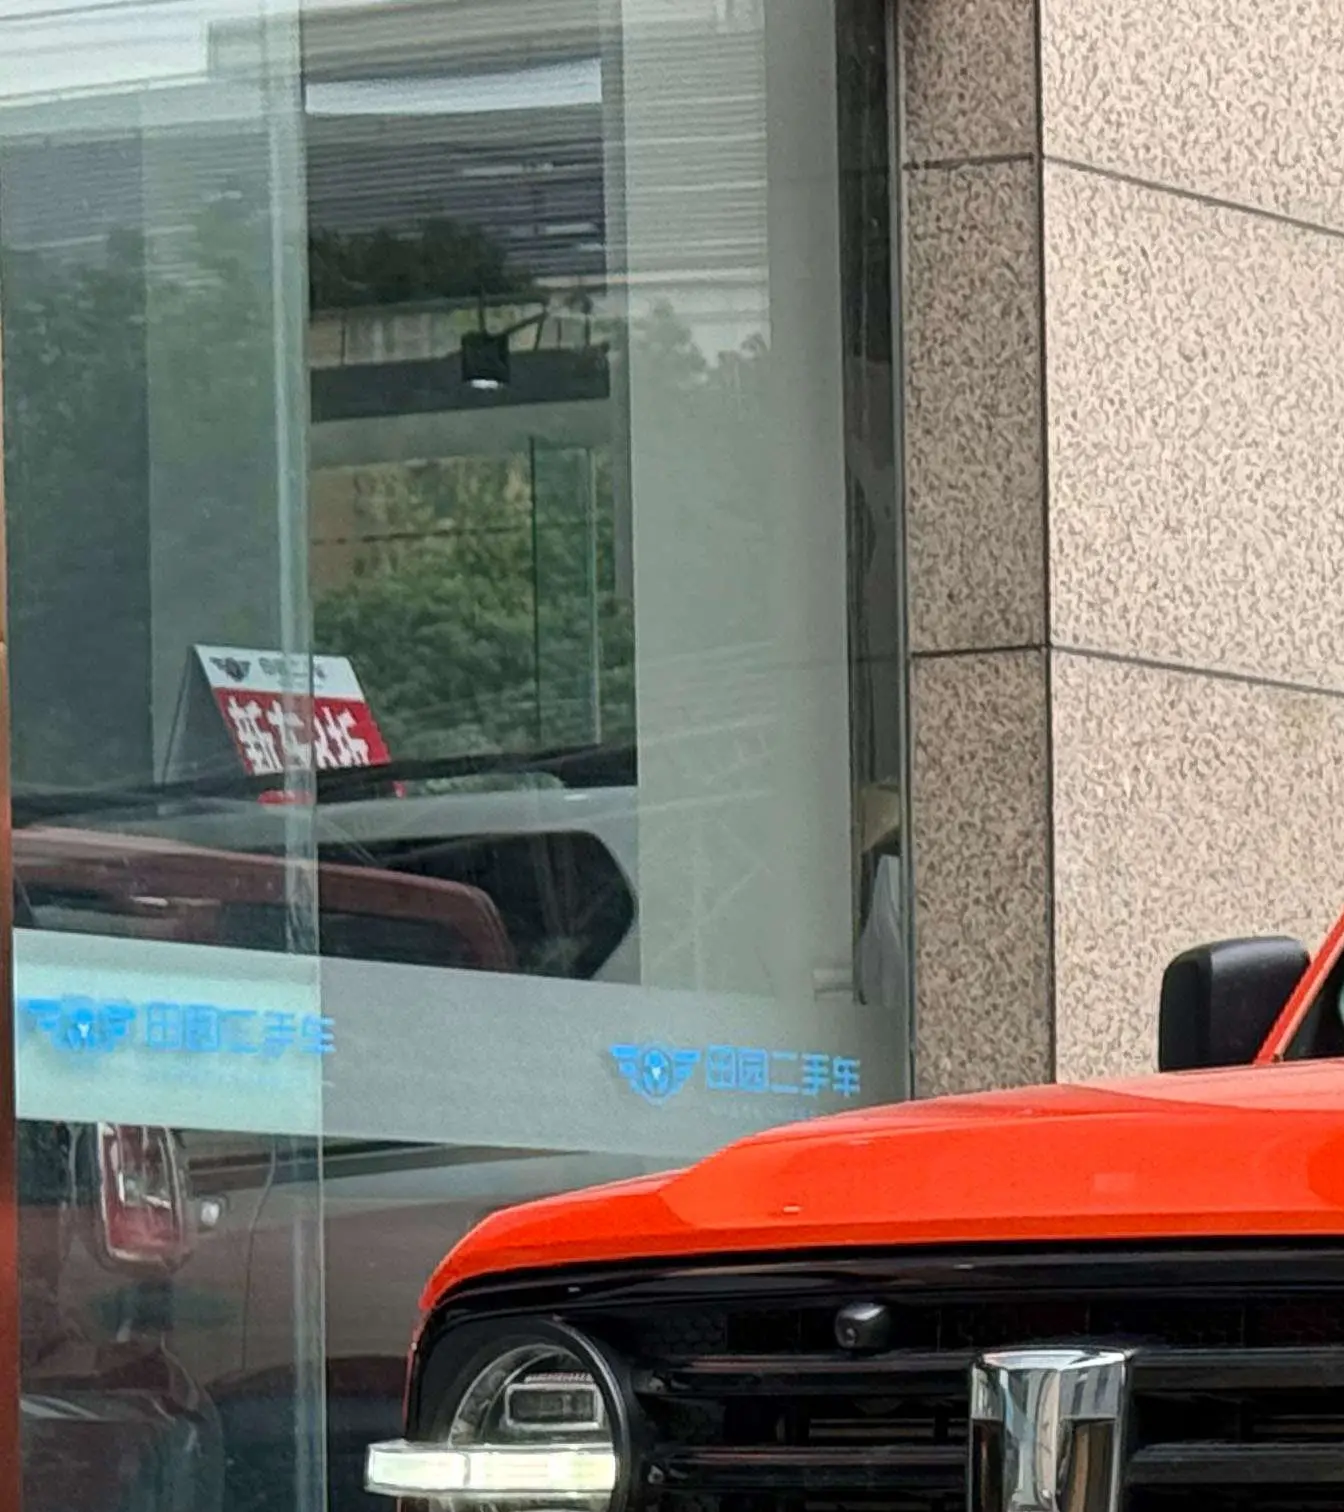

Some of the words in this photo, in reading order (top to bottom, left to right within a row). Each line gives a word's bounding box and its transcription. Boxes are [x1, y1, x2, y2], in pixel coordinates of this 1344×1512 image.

[705, 1044, 861, 1097] 田园二手车
